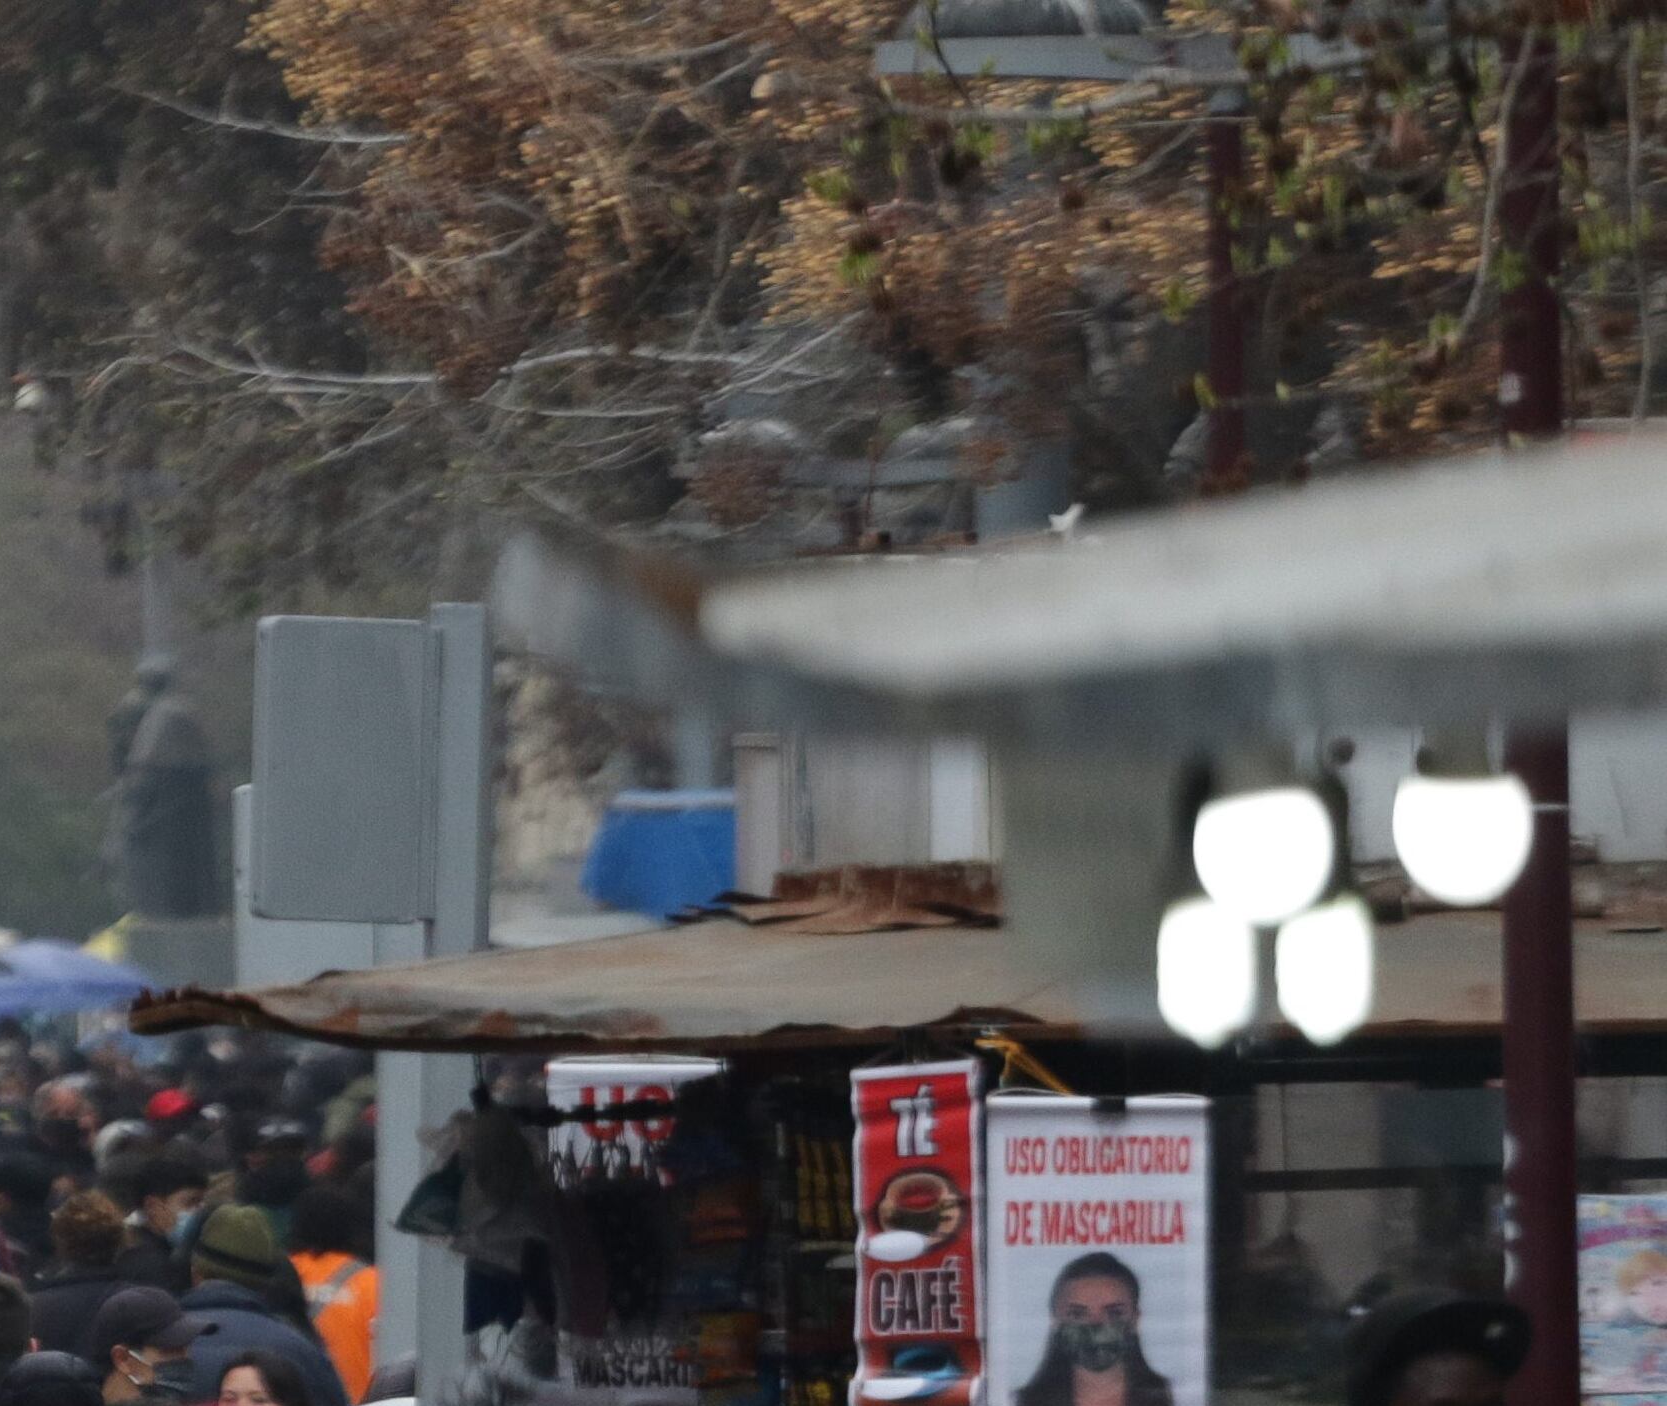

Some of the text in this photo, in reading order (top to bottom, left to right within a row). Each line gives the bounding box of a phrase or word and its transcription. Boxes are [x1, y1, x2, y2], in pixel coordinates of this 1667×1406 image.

[890, 1084, 940, 1157] TÉ
[1005, 1136, 1192, 1175] USO OBLIGATORIO
[1005, 1200, 1185, 1245] DE MASCARILLA
[870, 1256, 964, 1336] CAFÉ
